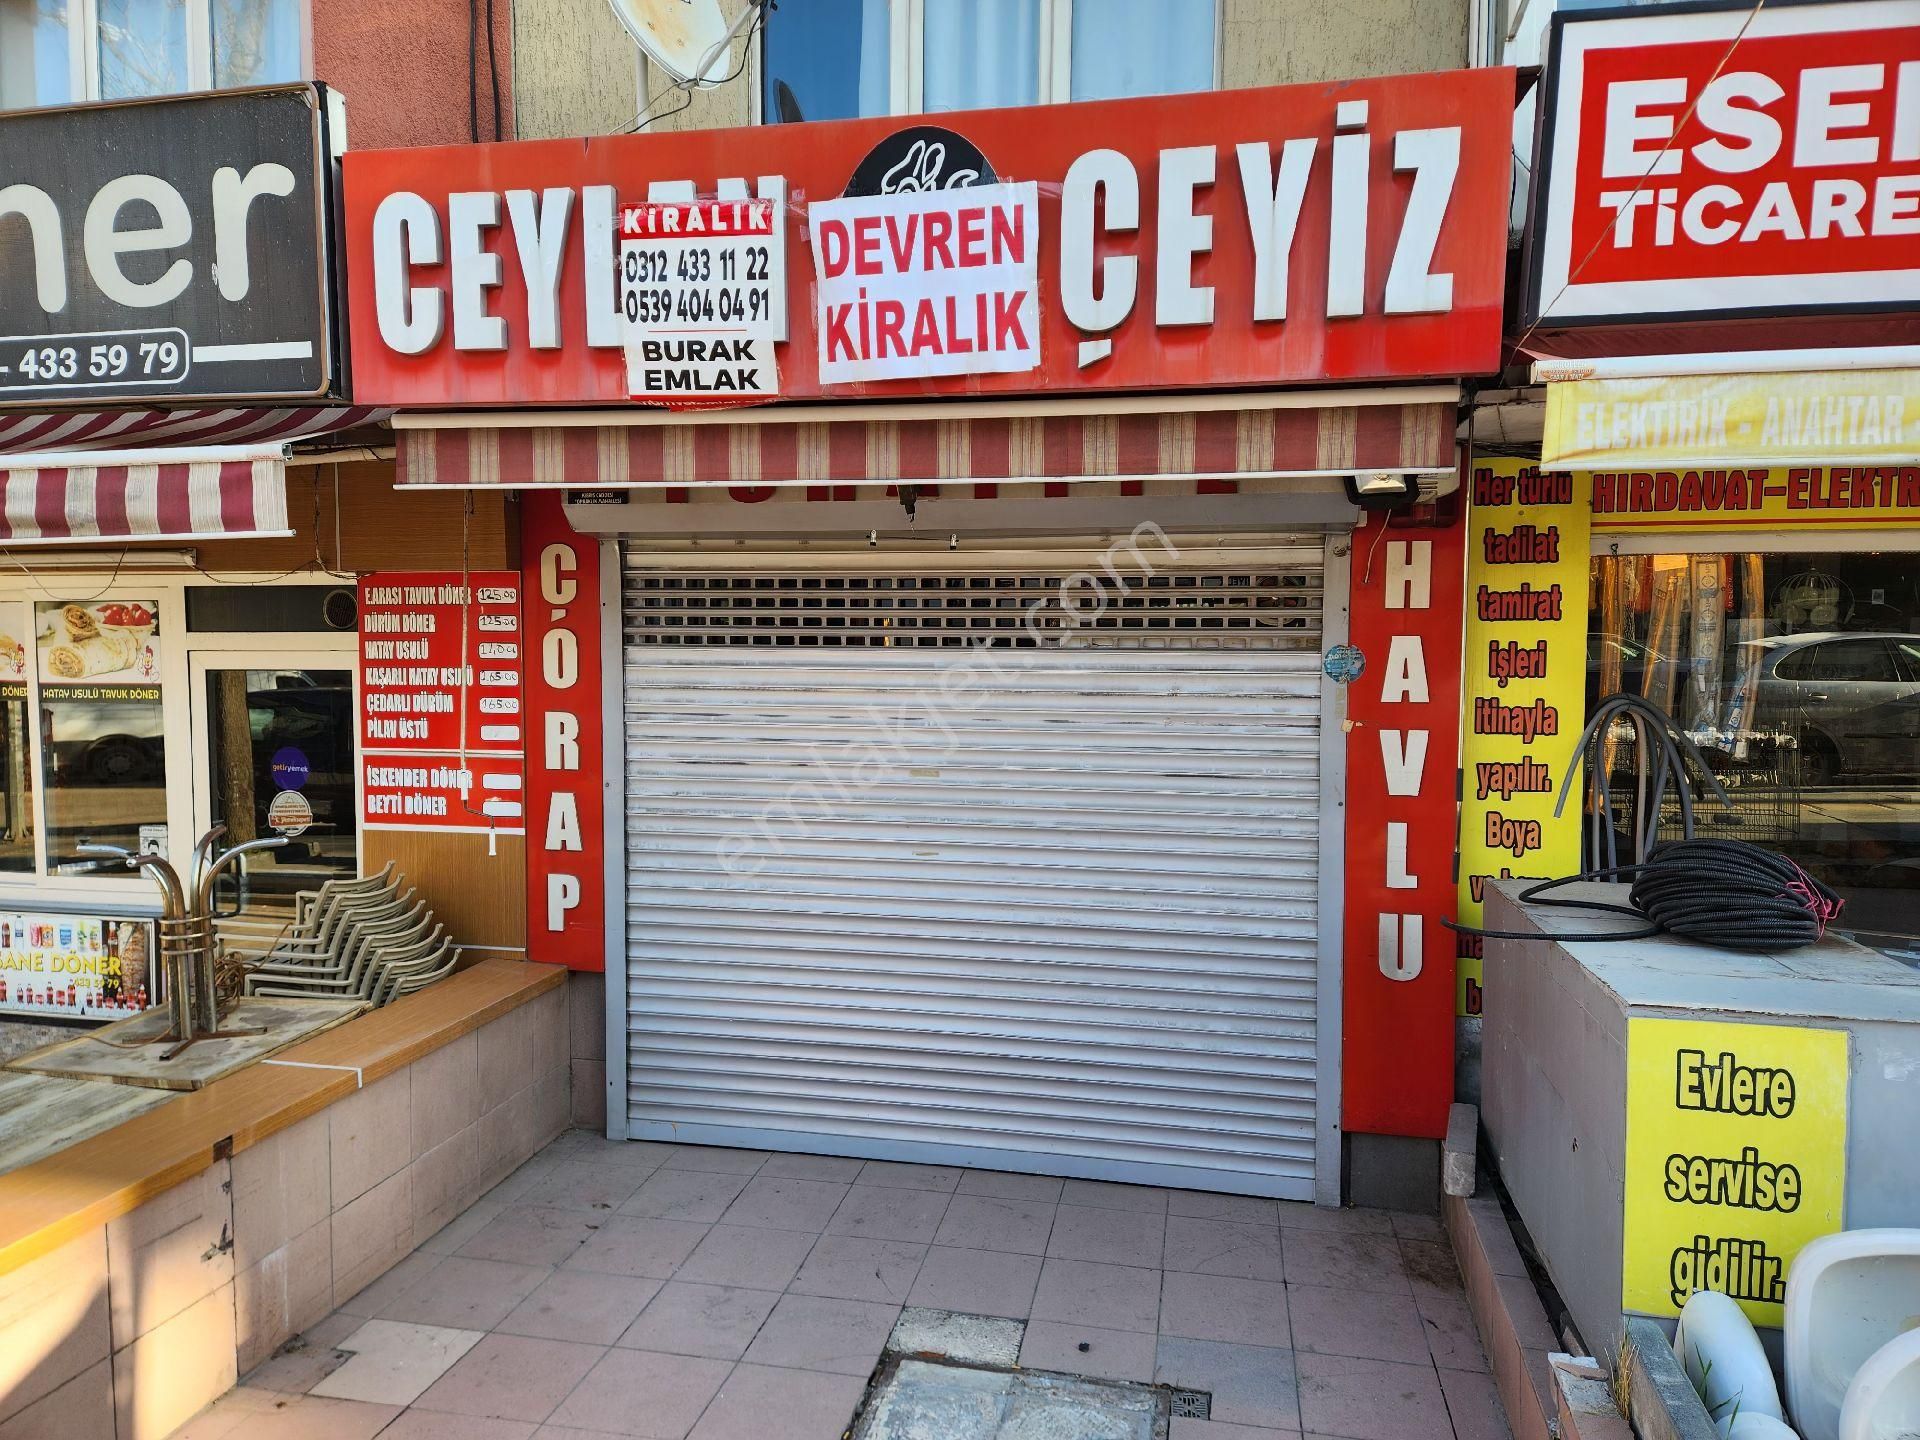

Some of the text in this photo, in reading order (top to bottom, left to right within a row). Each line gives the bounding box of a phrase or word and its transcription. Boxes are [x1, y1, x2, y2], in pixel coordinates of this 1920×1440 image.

[0, 163, 295, 313] ner
[820, 205, 1025, 279] DEVREN
[1061, 100, 1461, 369] ÇEYİZ
[625, 247, 768, 282] 0312 433 11 22
[625, 287, 768, 323] 0539 404 04 91
[826, 286, 1030, 363] KİRALIK
[19, 341, 179, 380] 433 59 79
[642, 339, 757, 361] BURAK
[644, 369, 760, 391] EMLAK
[1761, 396, 1905, 446] ANAHTAR
[1474, 466, 1573, 507] Her türlü
[1484, 526, 1559, 564] tadilat
[404, 587, 437, 605] TAVUK
[1477, 582, 1562, 622] tamirat
[364, 611, 436, 632] DÜRÜM DÖNER
[364, 637, 429, 659] HATAY USULÜ
[1489, 640, 1548, 688] işleri
[42, 687, 160, 700] HATAY USULÜ TAVUK DÖNER
[365, 664, 474, 689] KAŞARLI HATAY USUÜ
[366, 691, 454, 715] ÇEDARLI DÜRÜM
[1475, 697, 1558, 744] itinayla
[367, 717, 429, 739] PİLAV ÜSTÜ
[540, 543, 583, 932] ÇORAP
[367, 764, 428, 788] İSKENDER
[1379, 540, 1432, 981] HAVLU
[1477, 756, 1553, 801] yapılır.
[367, 791, 447, 816] BEYTİ DÖNER
[1486, 811, 1542, 857] Boya
[1469, 875, 1495, 903] v
[51, 948, 122, 976] DÖNER
[1676, 1049, 1795, 1118] Evlere
[1664, 1146, 1801, 1213] servise
